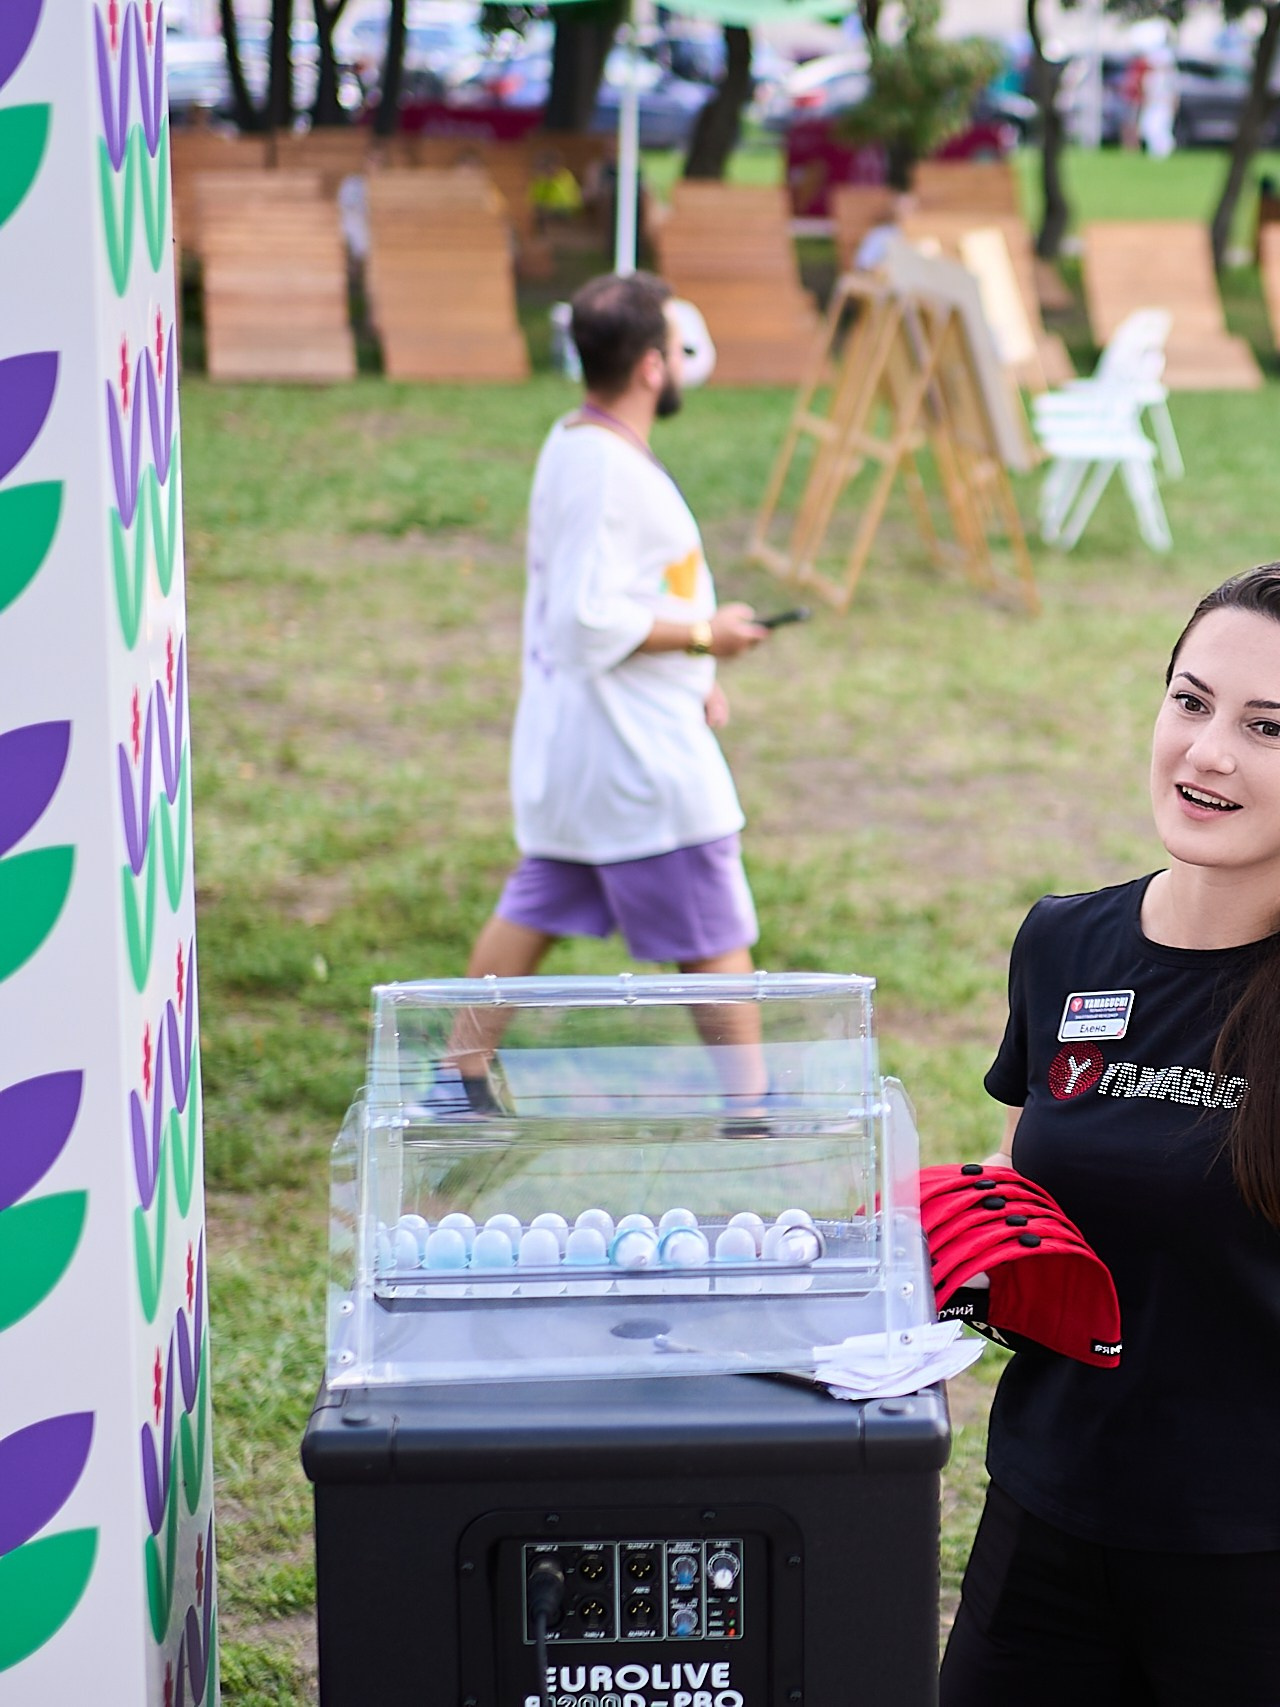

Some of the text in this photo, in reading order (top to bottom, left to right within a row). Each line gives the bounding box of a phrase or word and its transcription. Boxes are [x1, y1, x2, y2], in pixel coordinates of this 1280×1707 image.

[1084, 997, 1129, 1009] YAMAGUCHI
[1080, 1024, 1107, 1033] Елена
[1064, 1055, 1092, 1094] Y
[546, 1662, 730, 1692] EUROLIVE
